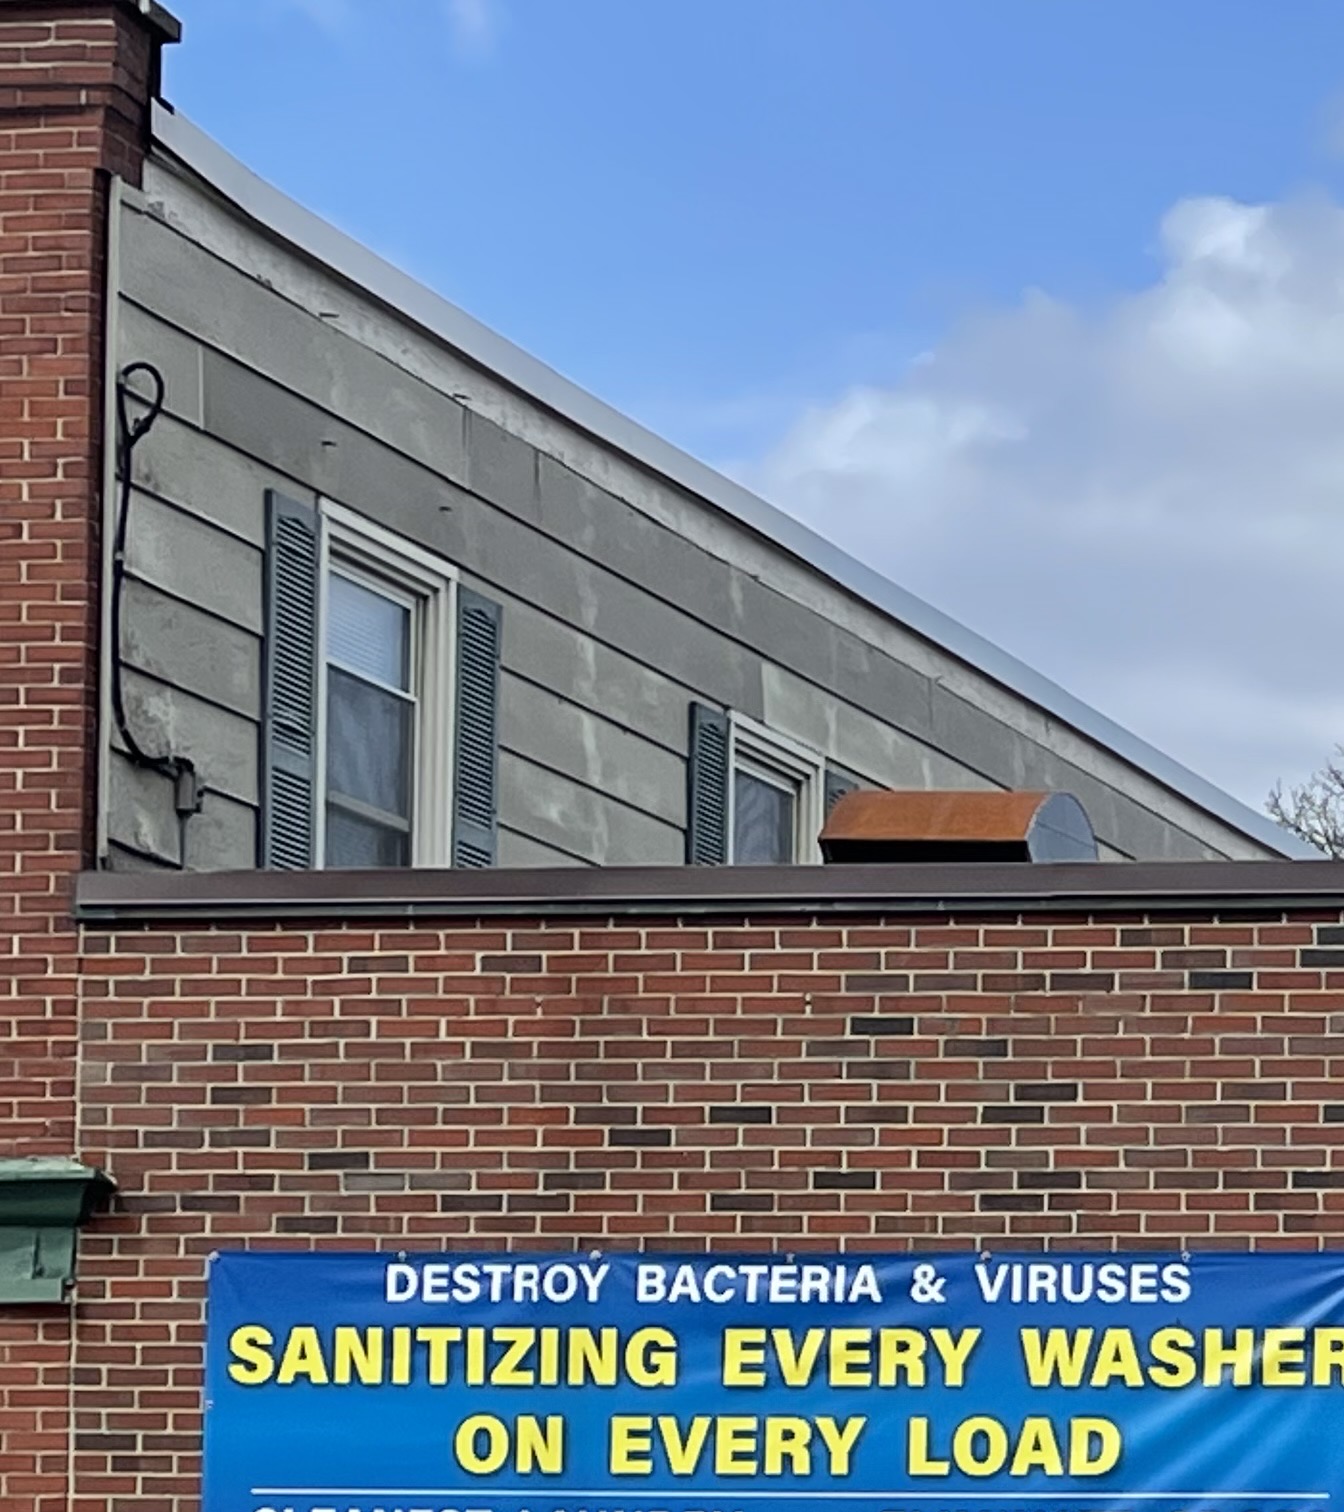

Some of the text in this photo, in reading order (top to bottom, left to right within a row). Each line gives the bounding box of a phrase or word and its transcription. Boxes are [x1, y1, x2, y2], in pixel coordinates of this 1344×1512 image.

[386, 1263, 1192, 1303] DESTROY BACTERIA & VIRUSES
[228, 1325, 679, 1387] SANITIZING
[722, 1327, 982, 1388] EVERY
[454, 1415, 1122, 1477] ON EVERY LOAD
